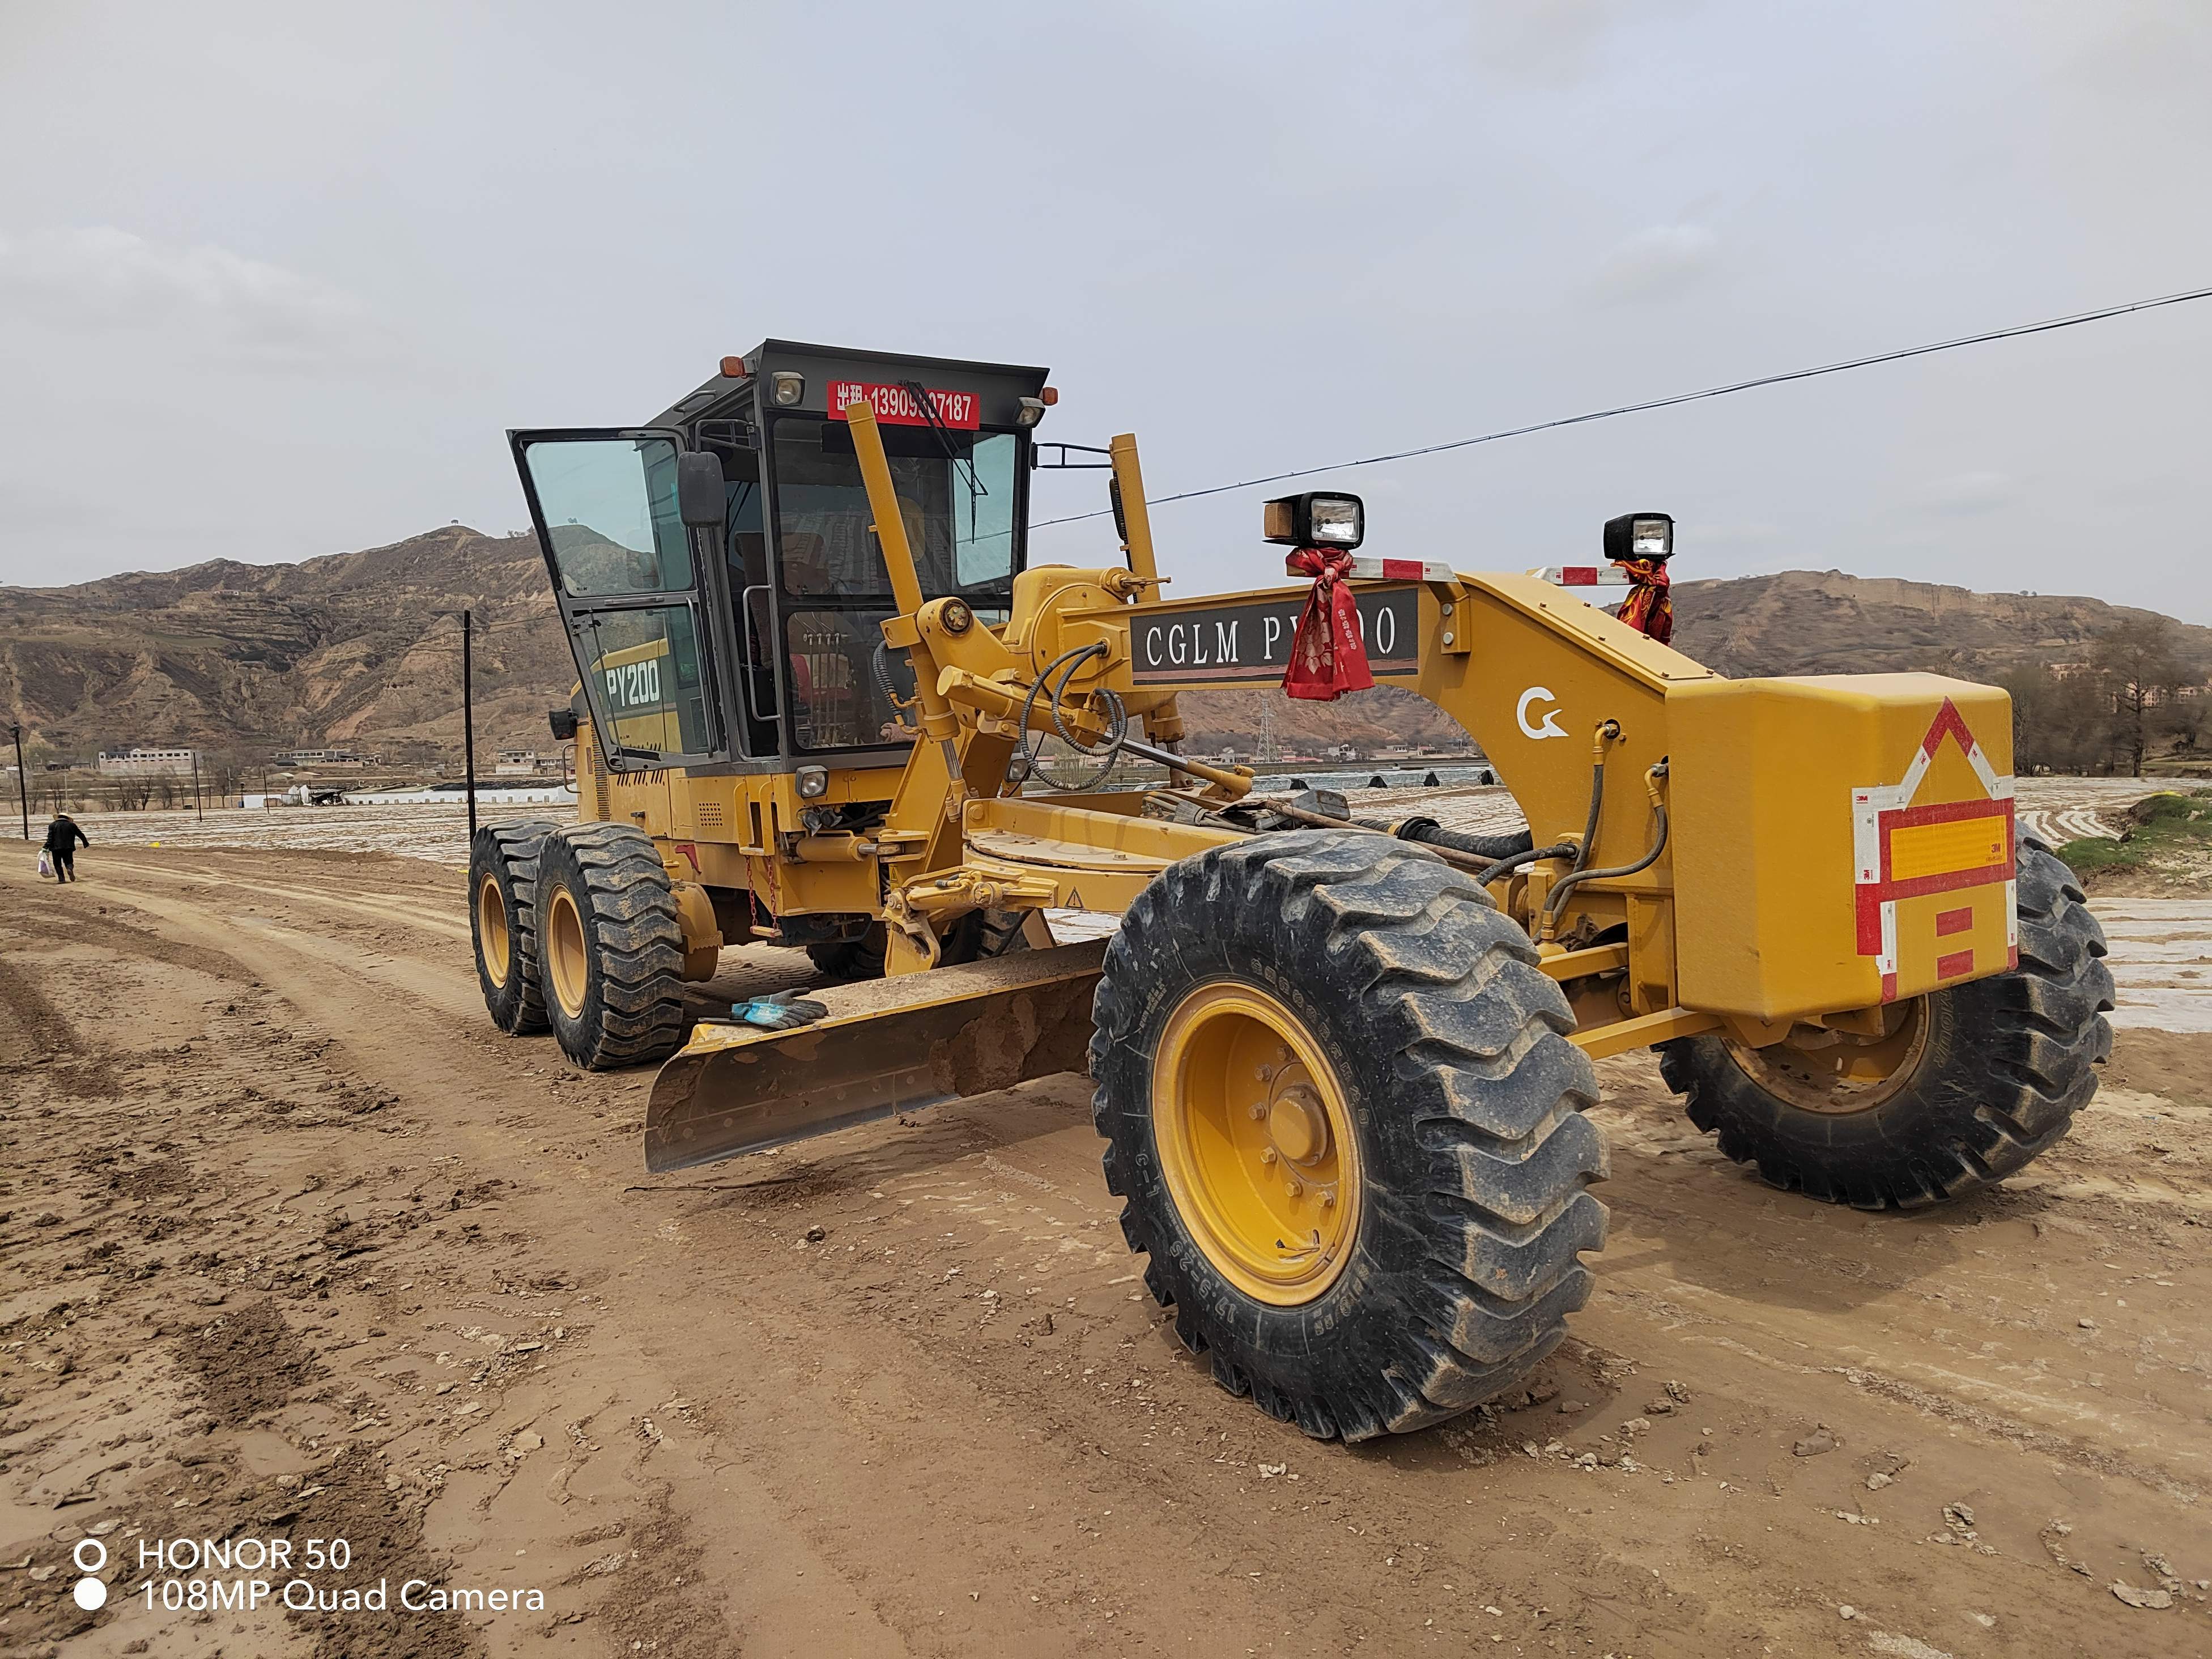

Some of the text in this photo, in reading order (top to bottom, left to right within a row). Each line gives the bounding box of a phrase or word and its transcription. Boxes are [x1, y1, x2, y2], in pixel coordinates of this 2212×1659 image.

[1146, 620, 1239, 666] CGLM
[606, 659, 660, 709] PY200
[1991, 843, 2001, 853] 3M
[1863, 869, 1870, 880] 3M
[1135, 1153, 1160, 1198] L-3
[1170, 1241, 1236, 1324] 17.5-25
